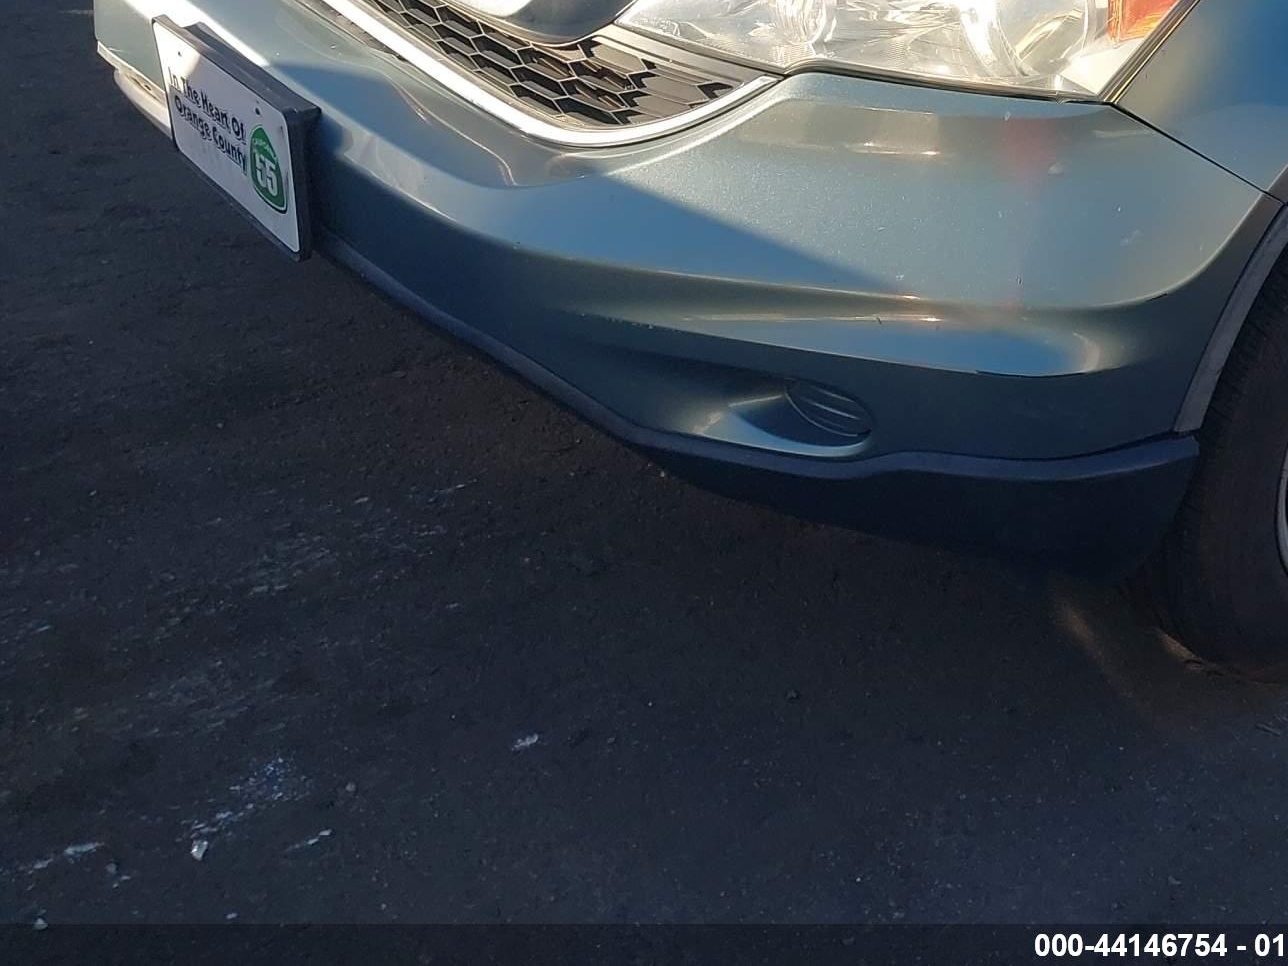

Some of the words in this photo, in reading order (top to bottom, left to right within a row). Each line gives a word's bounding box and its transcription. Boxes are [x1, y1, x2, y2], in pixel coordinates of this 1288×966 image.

[168, 66, 182, 90] In
[181, 76, 201, 107] The
[201, 90, 231, 132] Heart
[232, 117, 246, 142] Of
[175, 95, 212, 140] Orange
[212, 126, 247, 175] County
[255, 152, 278, 197] 55
